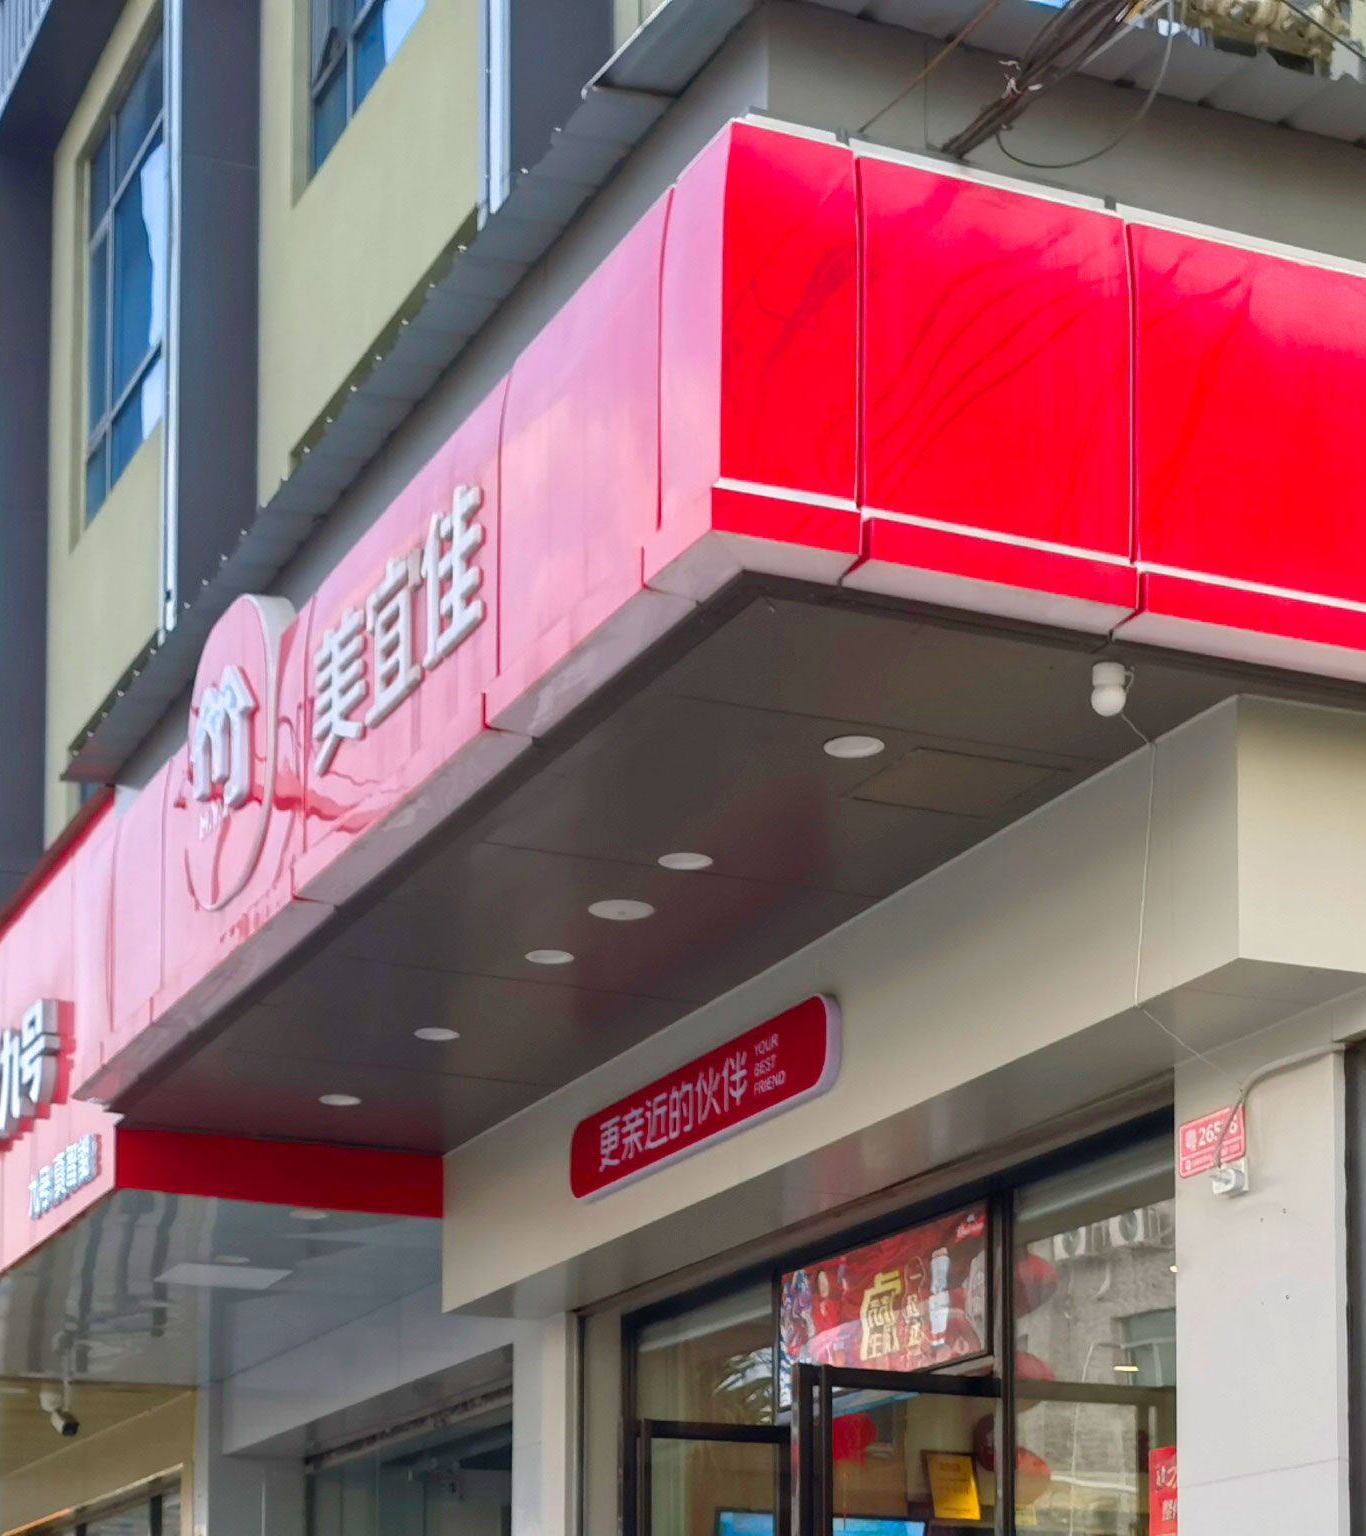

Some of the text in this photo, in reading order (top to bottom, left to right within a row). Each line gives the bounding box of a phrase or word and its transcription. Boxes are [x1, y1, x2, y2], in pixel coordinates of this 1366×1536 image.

[314, 485, 485, 776] 美宜佳
[753, 1033, 779, 1056] YOUR
[753, 1054, 777, 1077] BEST
[753, 1070, 786, 1096] FRIEND
[598, 1051, 748, 1173] 更亲近的伙伴
